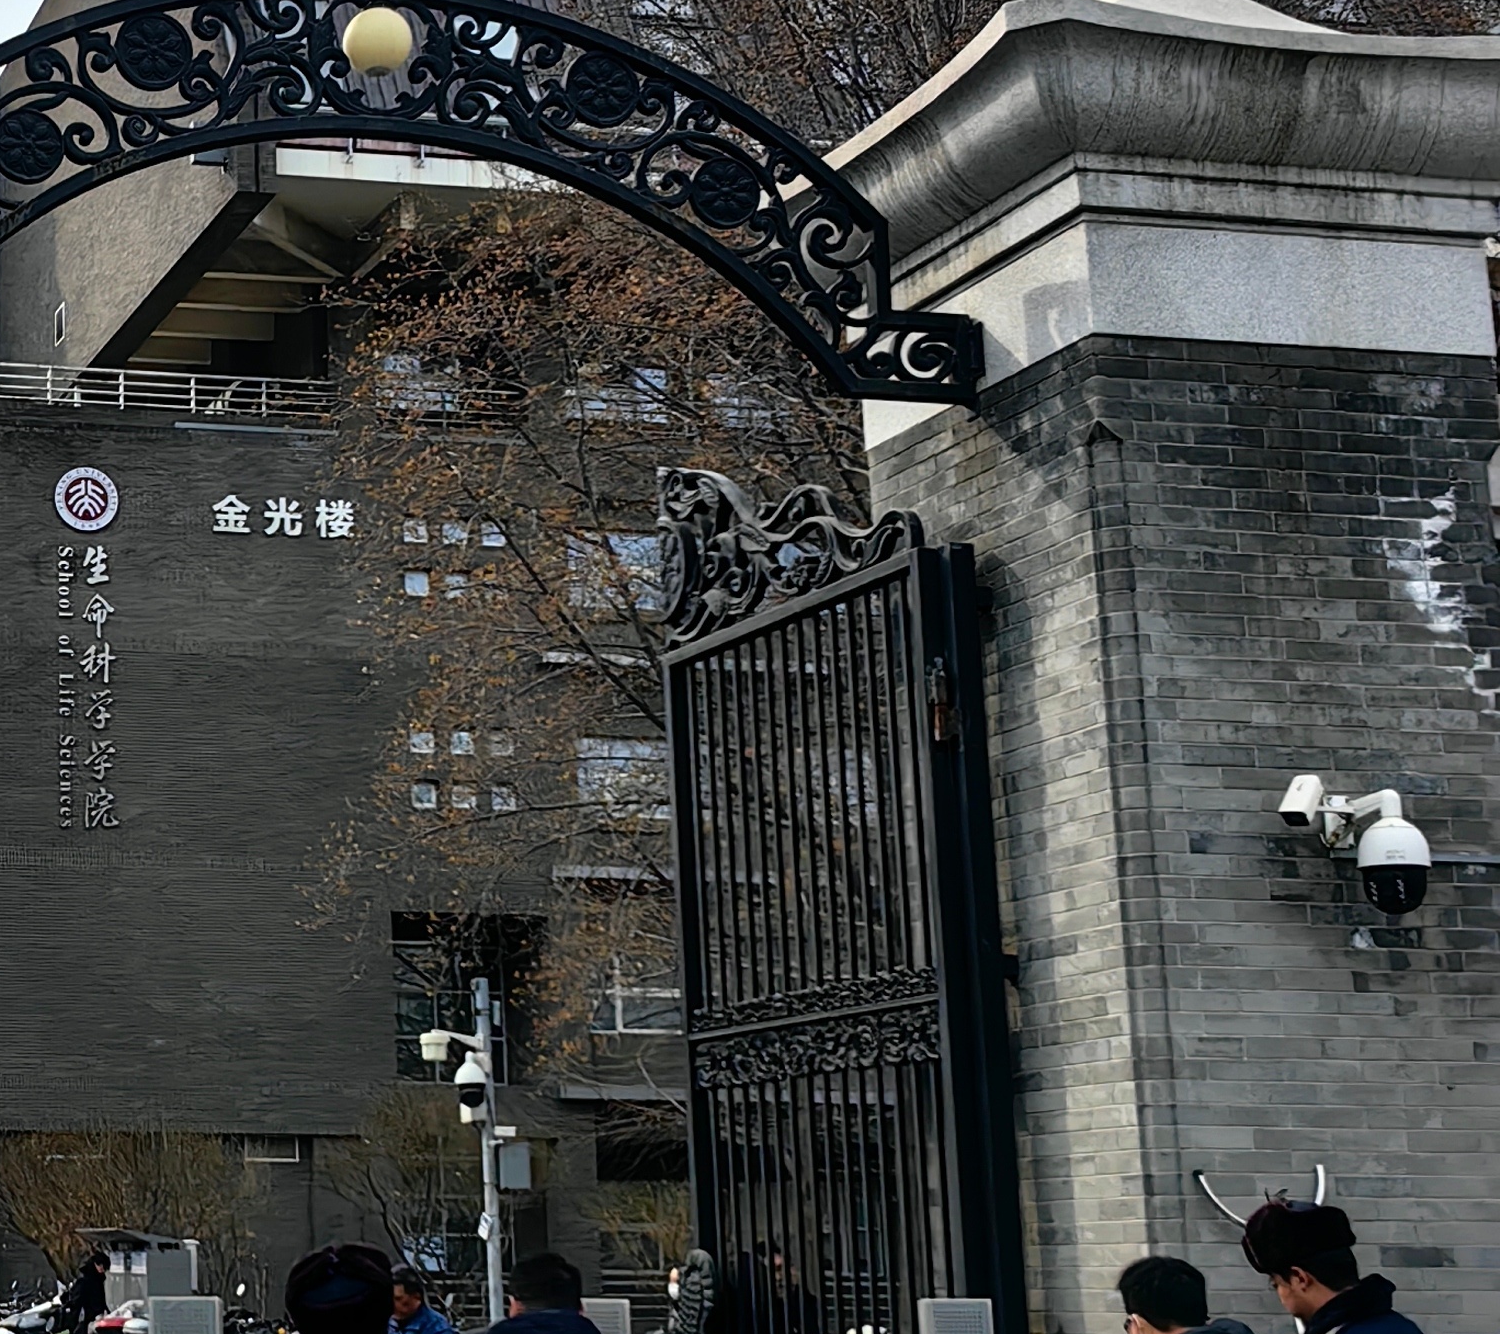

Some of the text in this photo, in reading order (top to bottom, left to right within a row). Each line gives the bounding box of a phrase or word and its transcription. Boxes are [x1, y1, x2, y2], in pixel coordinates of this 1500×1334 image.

[212, 494, 356, 538] 金光楼
[58, 546, 76, 828] School of Life Sciences
[80, 545, 120, 828] 生命科学学院
